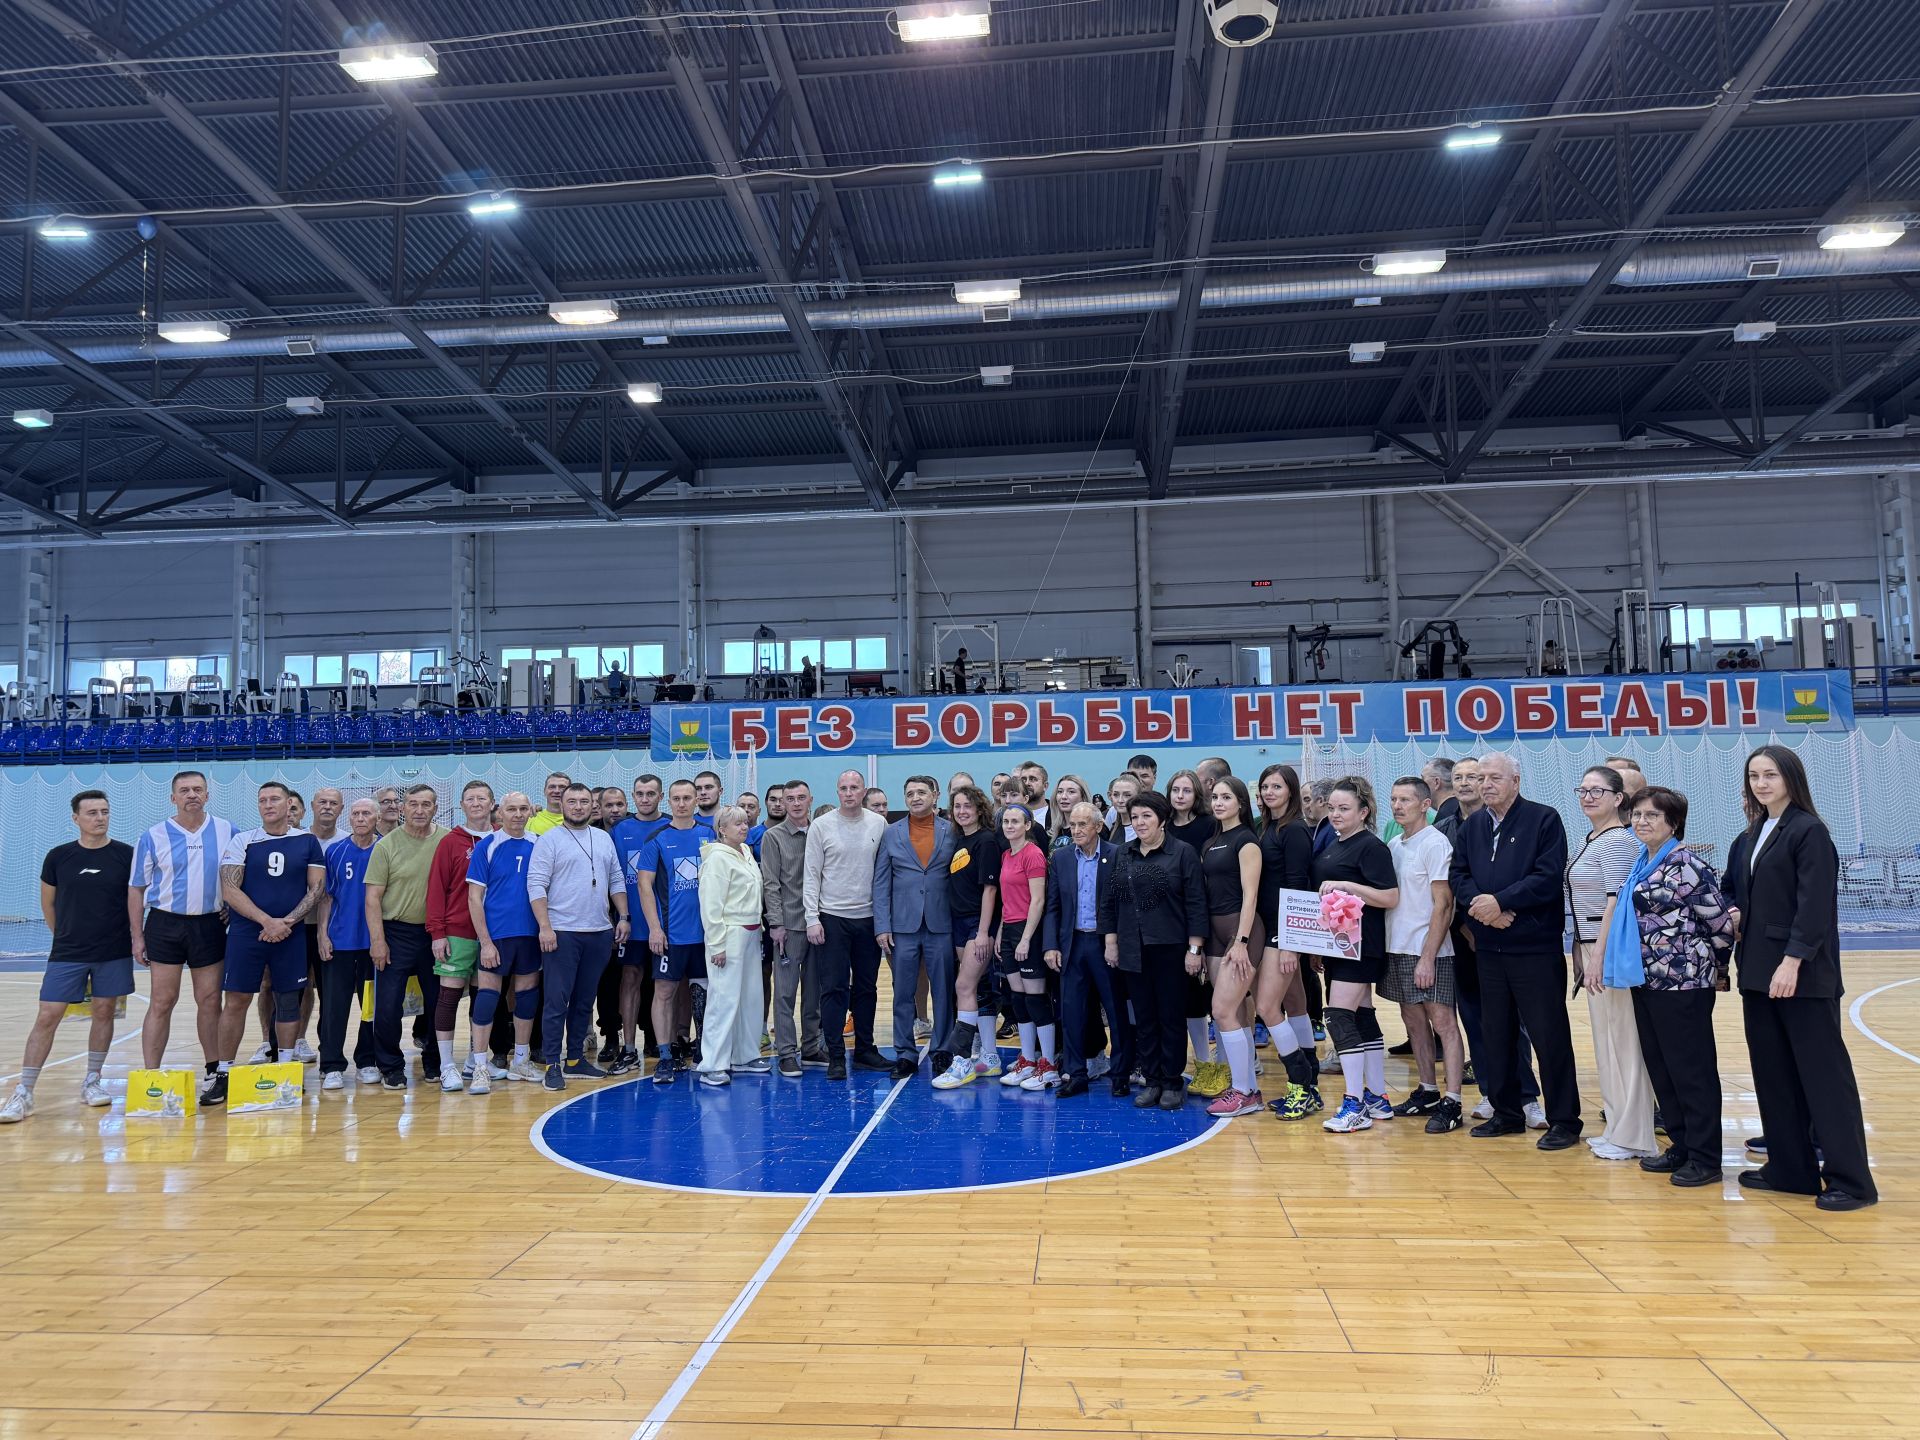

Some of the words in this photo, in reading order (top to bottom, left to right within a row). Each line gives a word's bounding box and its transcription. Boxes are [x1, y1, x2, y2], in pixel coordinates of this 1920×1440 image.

[729, 705, 856, 753] БЕЗ
[893, 695, 1192, 749] БОРЬБЫ
[1232, 690, 1364, 740] НЕТ
[1403, 678, 1759, 736] ПОБЕДЫ!
[267, 851, 285, 877] 9
[345, 861, 354, 880] 5
[515, 855, 523, 873] 7
[660, 955, 669, 973] 6
